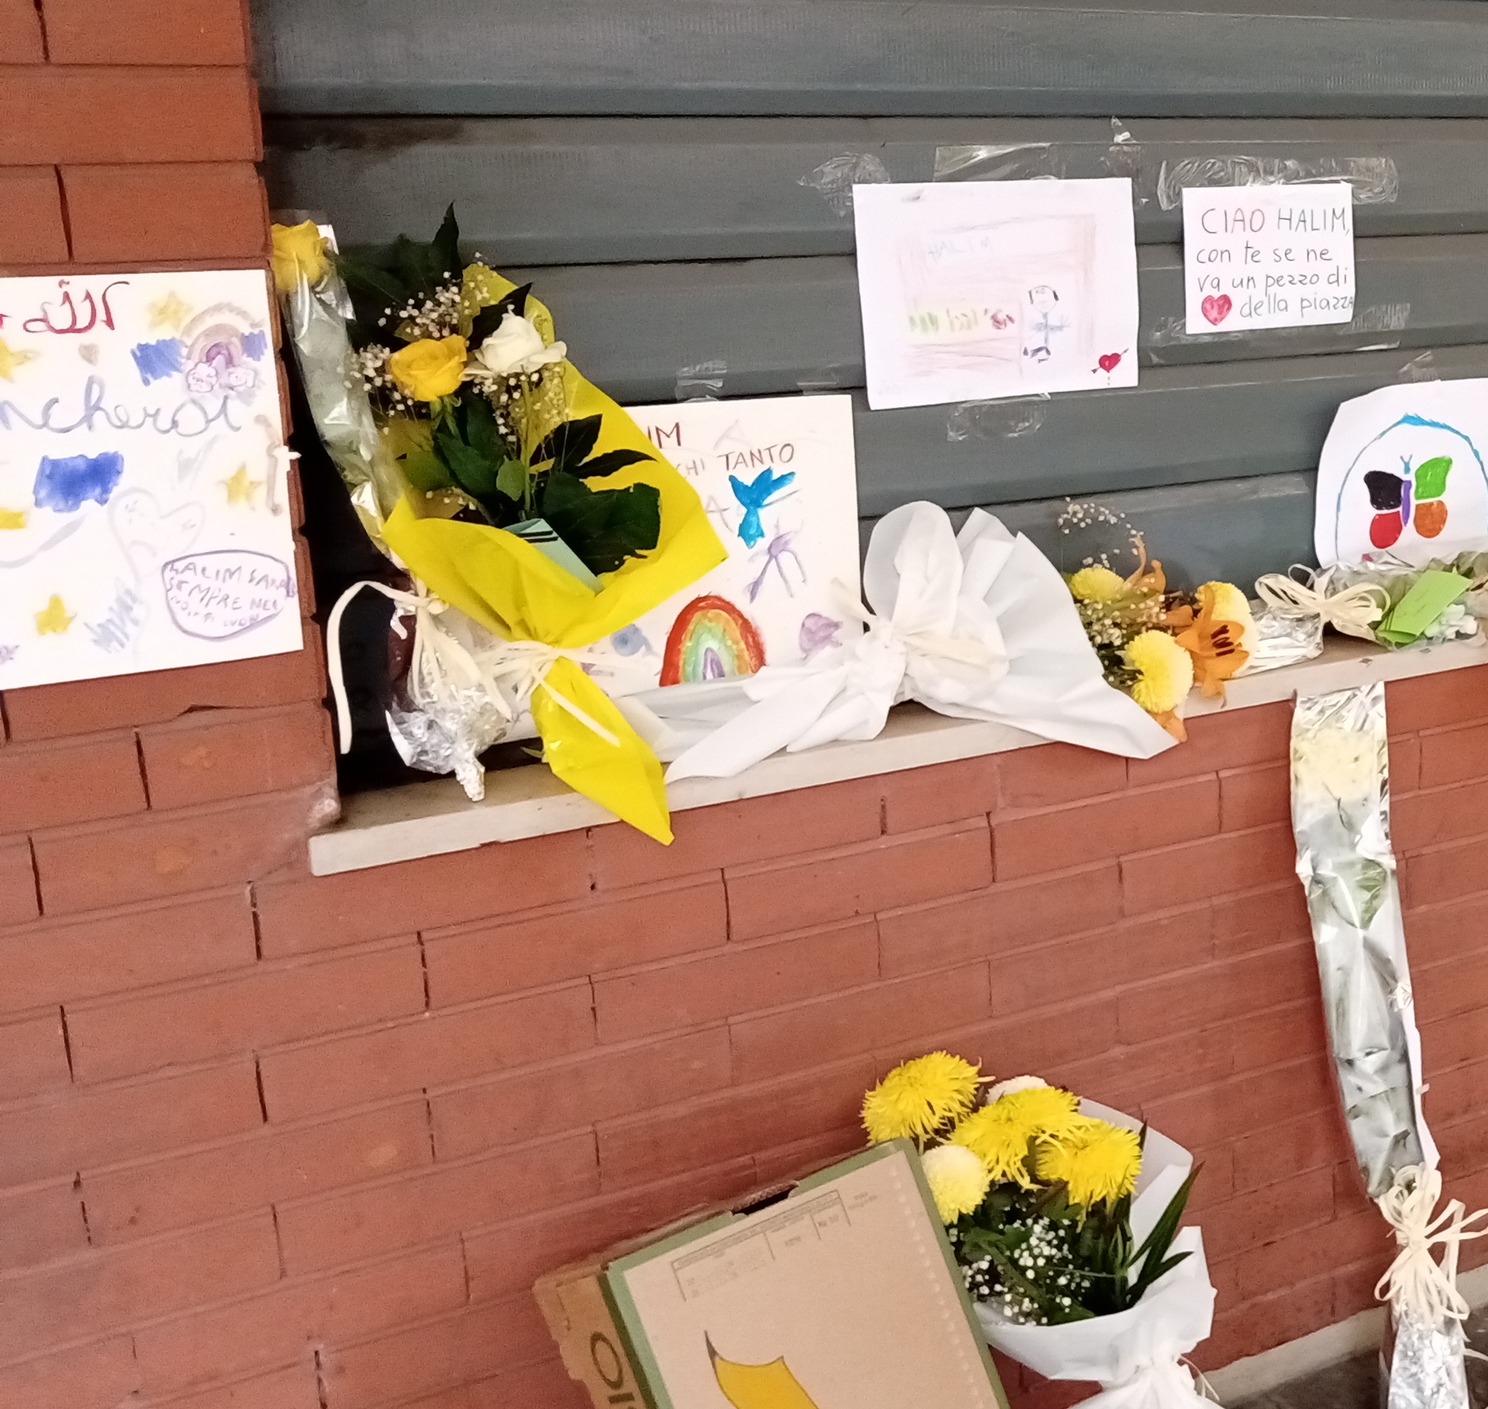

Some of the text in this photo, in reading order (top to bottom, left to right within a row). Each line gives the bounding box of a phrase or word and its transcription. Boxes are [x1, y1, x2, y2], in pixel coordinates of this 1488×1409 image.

[1201, 207, 1350, 235] CIAO HALIM,
[1196, 240, 1333, 264] con te se ne
[1197, 265, 1348, 297] va un pezzo di
[1240, 292, 1289, 318] della
[718, 442, 795, 471] TANTO
